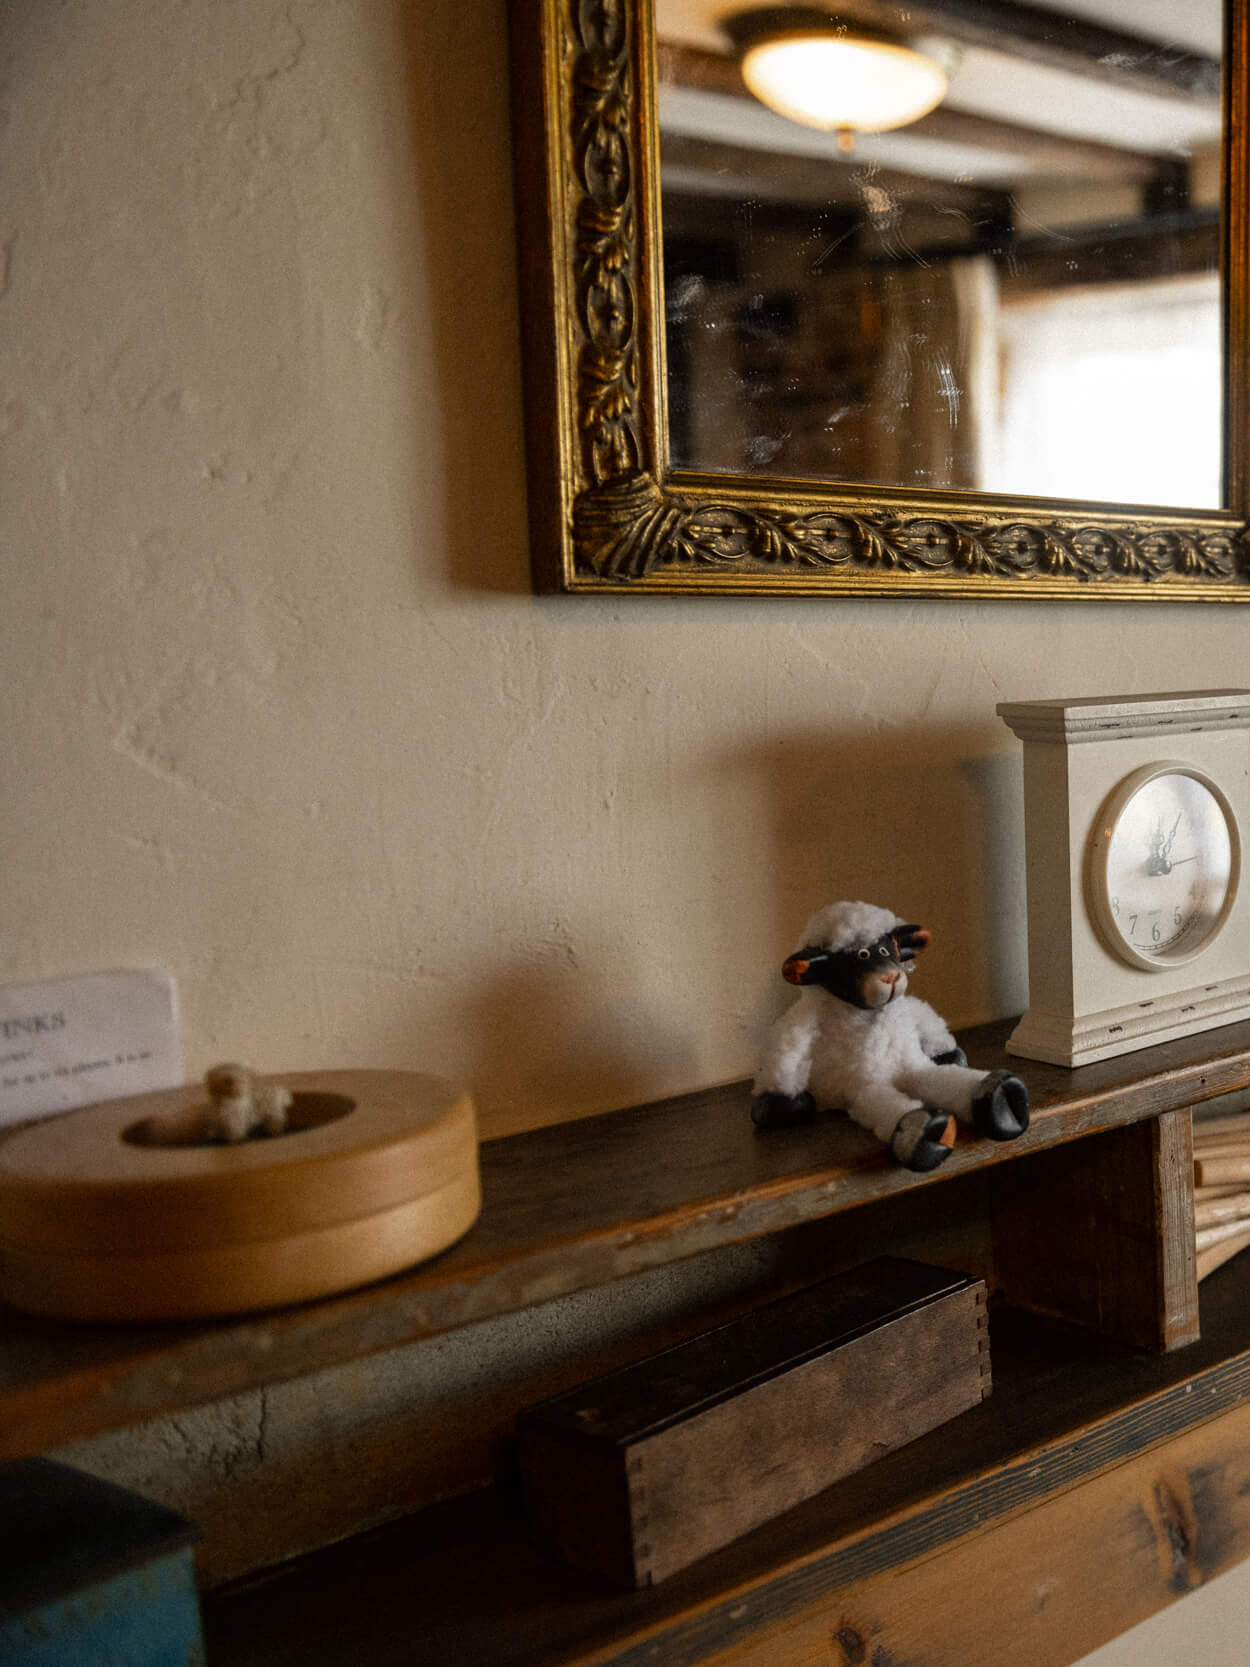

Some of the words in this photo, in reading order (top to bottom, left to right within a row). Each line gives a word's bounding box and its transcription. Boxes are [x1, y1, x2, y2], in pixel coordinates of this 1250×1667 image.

[1128, 914, 1138, 935] 7
[1174, 906, 1183, 925] 5
[1151, 921, 1160, 942] 6
[0, 1010, 66, 1038] INKS
